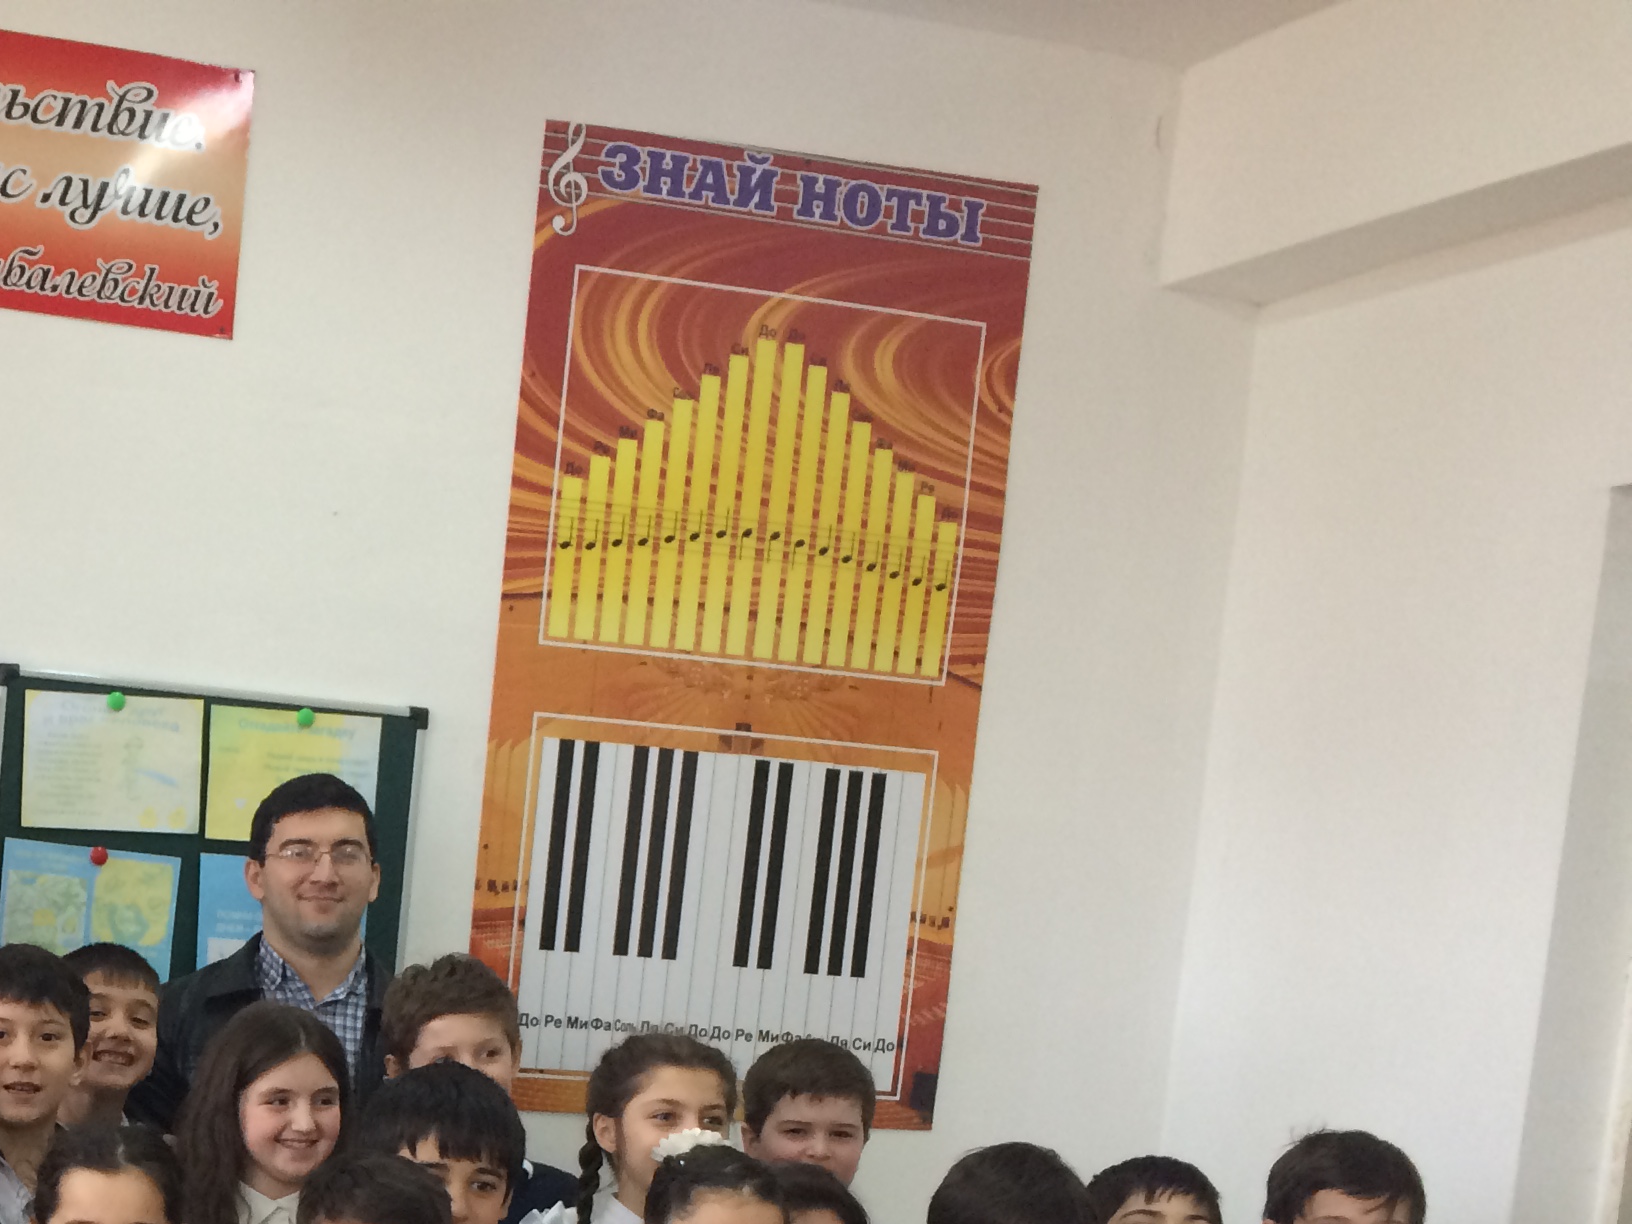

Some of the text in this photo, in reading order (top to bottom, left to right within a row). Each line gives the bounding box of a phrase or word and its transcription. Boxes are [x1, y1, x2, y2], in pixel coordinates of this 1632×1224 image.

[600, 144, 985, 243] ЗНАЙ НОТЫ
[519, 1013, 539, 1027] До
[544, 1015, 562, 1028] Ре
[567, 1016, 588, 1030] Ми
[591, 1018, 611, 1031] Фа
[688, 1024, 708, 1038] До
[710, 1025, 730, 1040] До
[735, 1029, 753, 1042] Ре
[757, 1030, 778, 1043] Ми
[852, 1038, 871, 1051] Си
[874, 1038, 895, 1053] До
